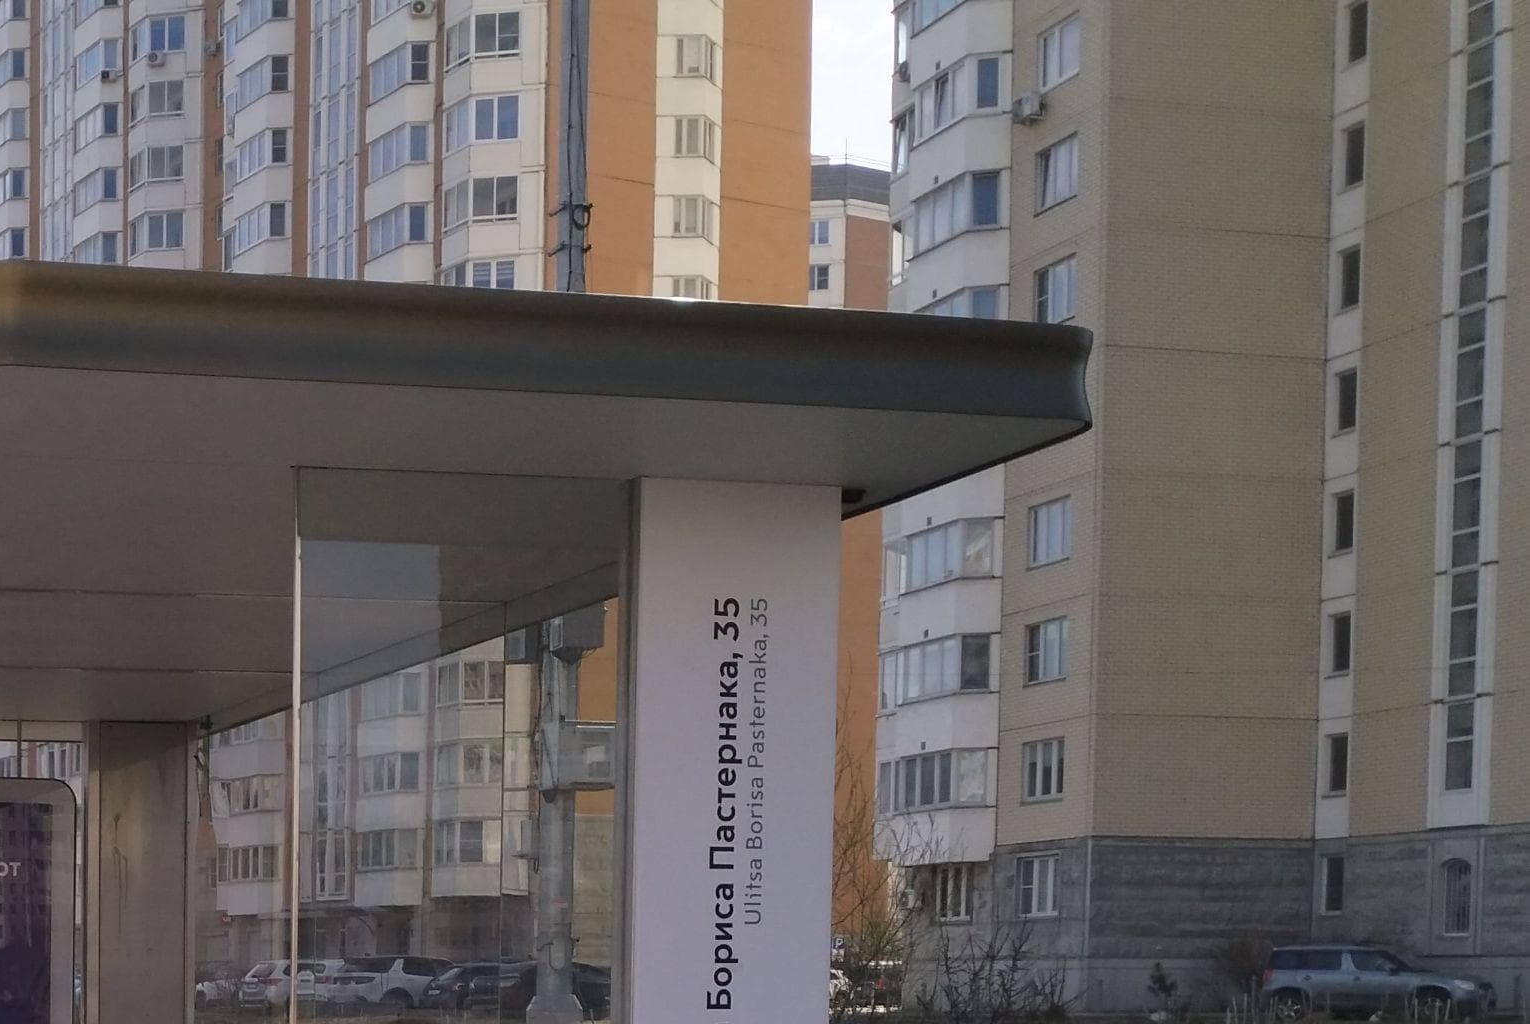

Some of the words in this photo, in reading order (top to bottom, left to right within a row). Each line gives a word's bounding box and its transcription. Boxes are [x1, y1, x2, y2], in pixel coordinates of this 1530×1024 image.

[713, 597, 740, 642] 35
[750, 597, 768, 627] 35
[747, 633, 770, 768] Pasternaka,
[709, 652, 744, 870] Пастернака,
[745, 776, 764, 850] Borisa
[743, 857, 762, 925] Ulitsa
[706, 883, 739, 1010] Бориса
